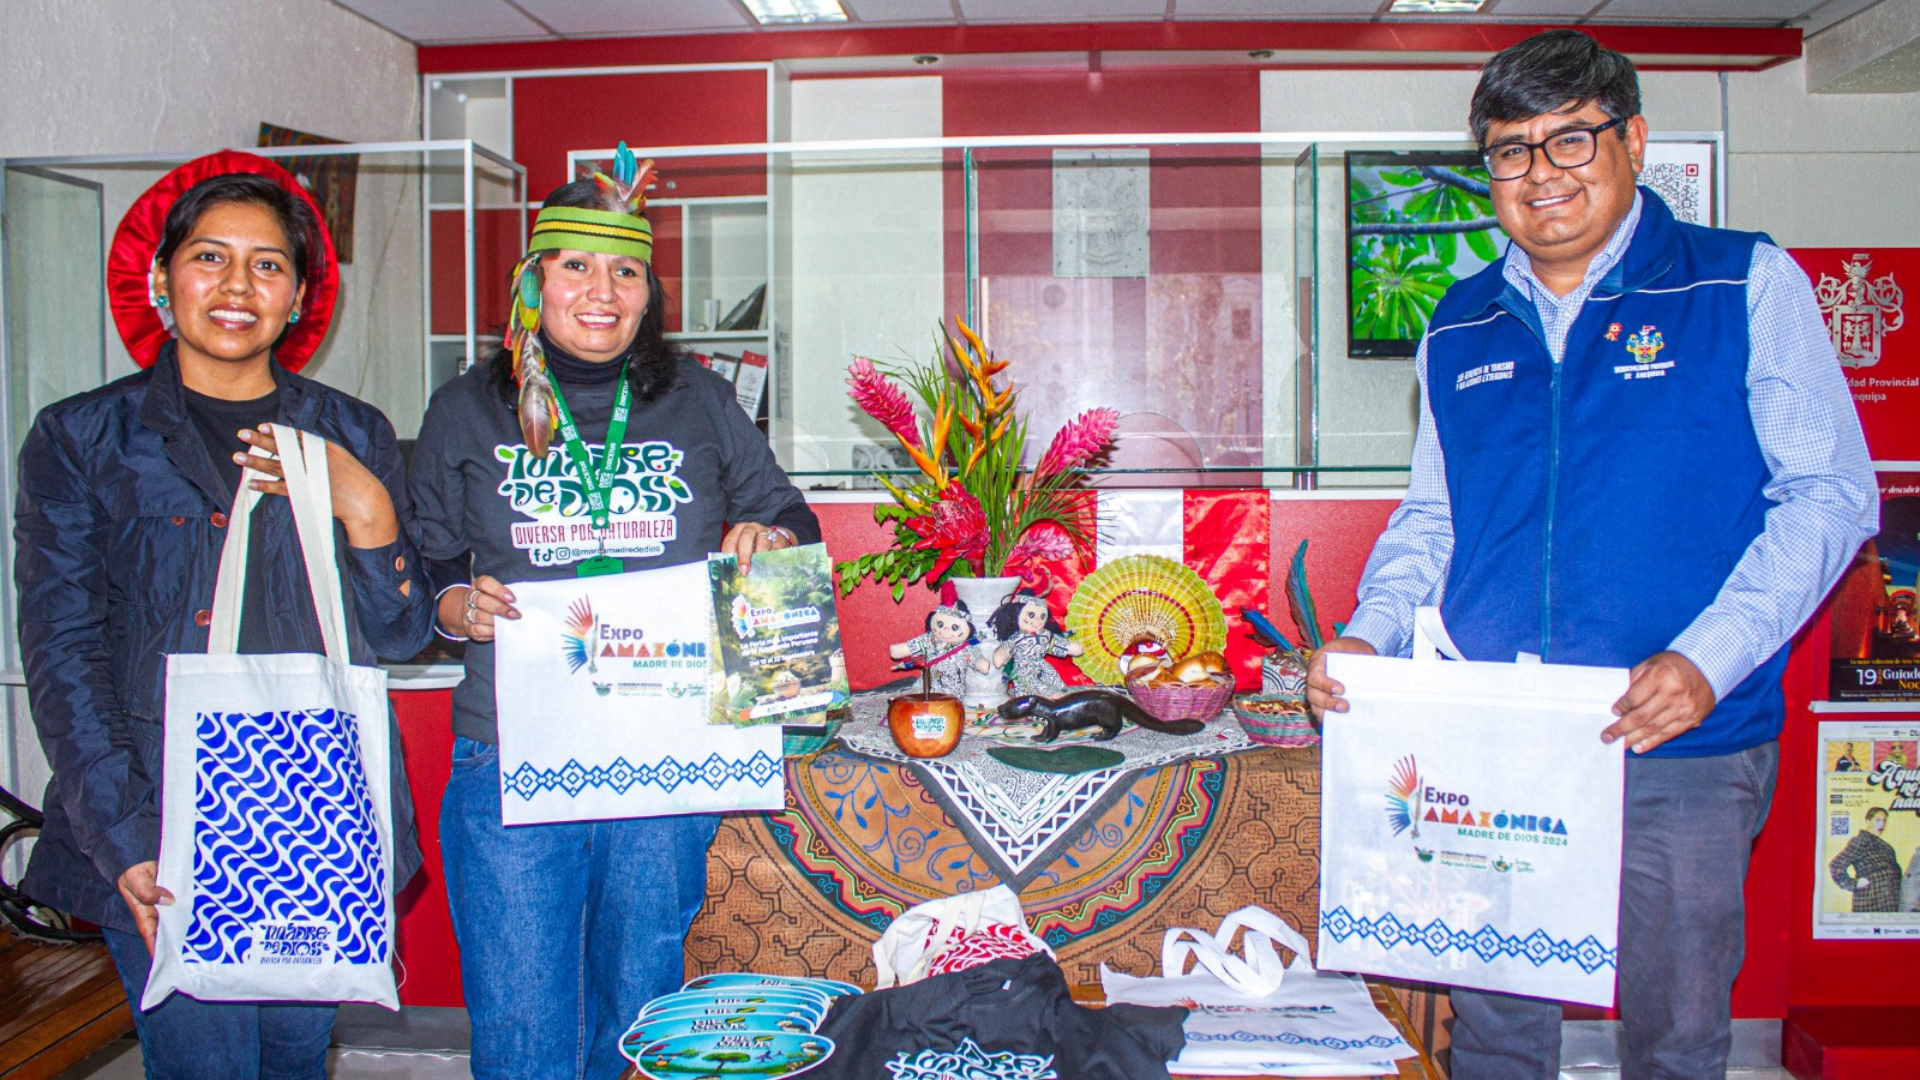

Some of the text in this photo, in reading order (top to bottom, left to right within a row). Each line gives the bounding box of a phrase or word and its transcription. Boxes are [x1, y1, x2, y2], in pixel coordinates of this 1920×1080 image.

[1869, 377, 1919, 387] Provincial
[1852, 392, 1886, 403] equipa
[558, 476, 672, 517] DOS
[515, 524, 566, 545] DIVERSA
[600, 639, 706, 658] AMAZÓNI
[633, 660, 667, 668] MADRE
[671, 660, 683, 668] DE
[1856, 669, 1877, 685] 19
[1423, 806, 1568, 835] AMAZÓNICA
[1458, 828, 1568, 846] MADRE DE DIOS 2024
[281, 941, 322, 956] DIOS
